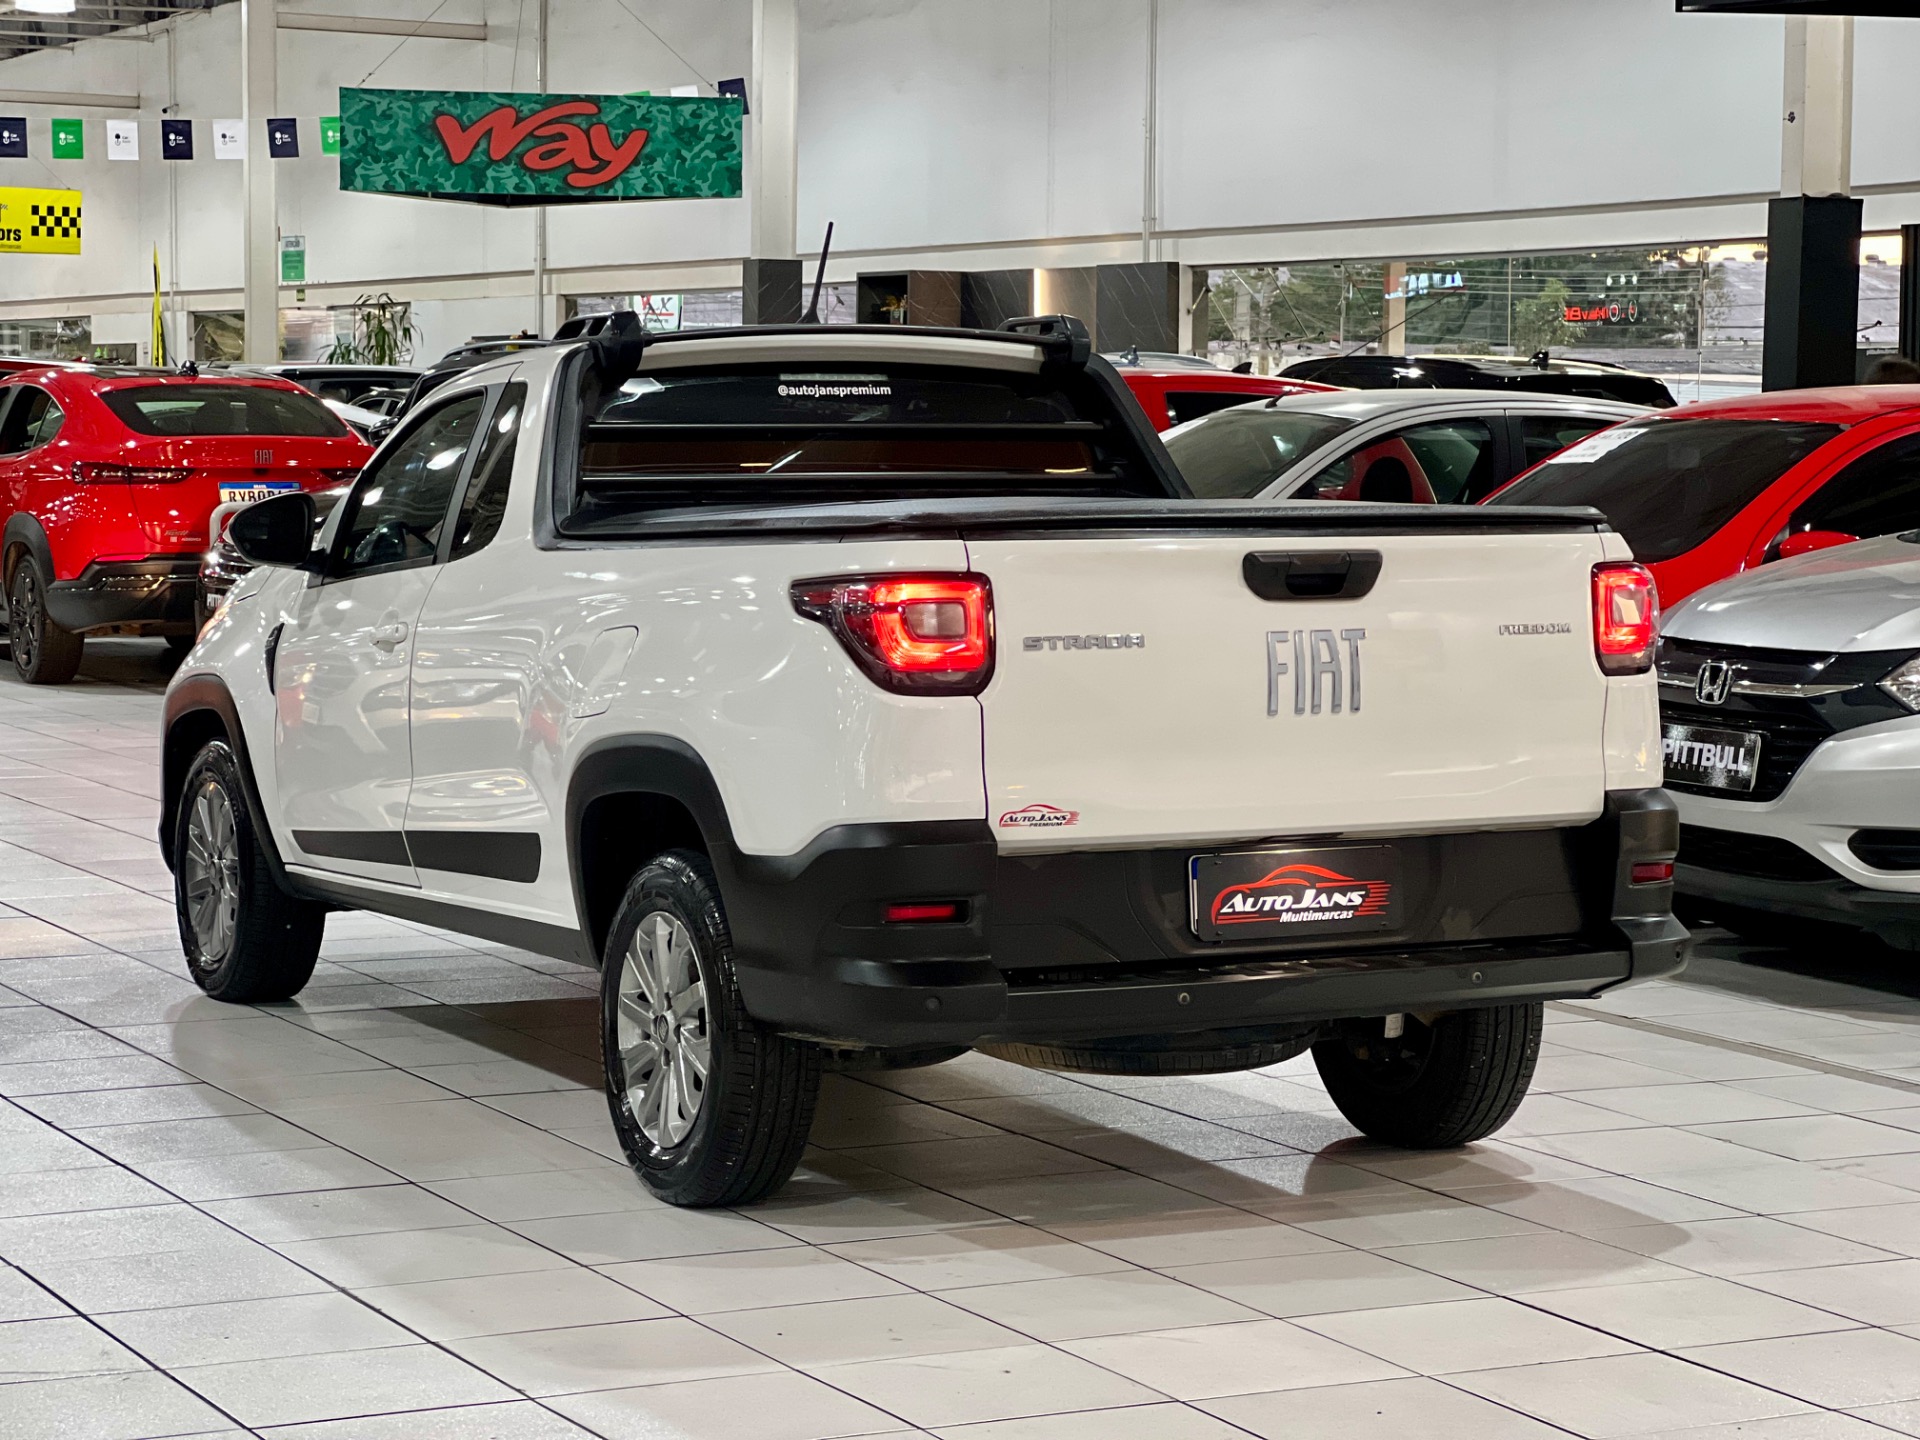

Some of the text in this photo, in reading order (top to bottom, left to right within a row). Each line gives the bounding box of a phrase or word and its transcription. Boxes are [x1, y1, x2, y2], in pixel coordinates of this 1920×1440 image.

[435, 101, 649, 188] Way
[778, 384, 892, 398] @autojanspremium
[254, 449, 274, 465] FIAT
[1499, 622, 1572, 636] FREEDOM
[1022, 632, 1146, 652] STRADA
[1266, 628, 1368, 717] FIAT
[1661, 738, 1748, 773] PITTBULL
[1279, 909, 1354, 923] Multimarcas
